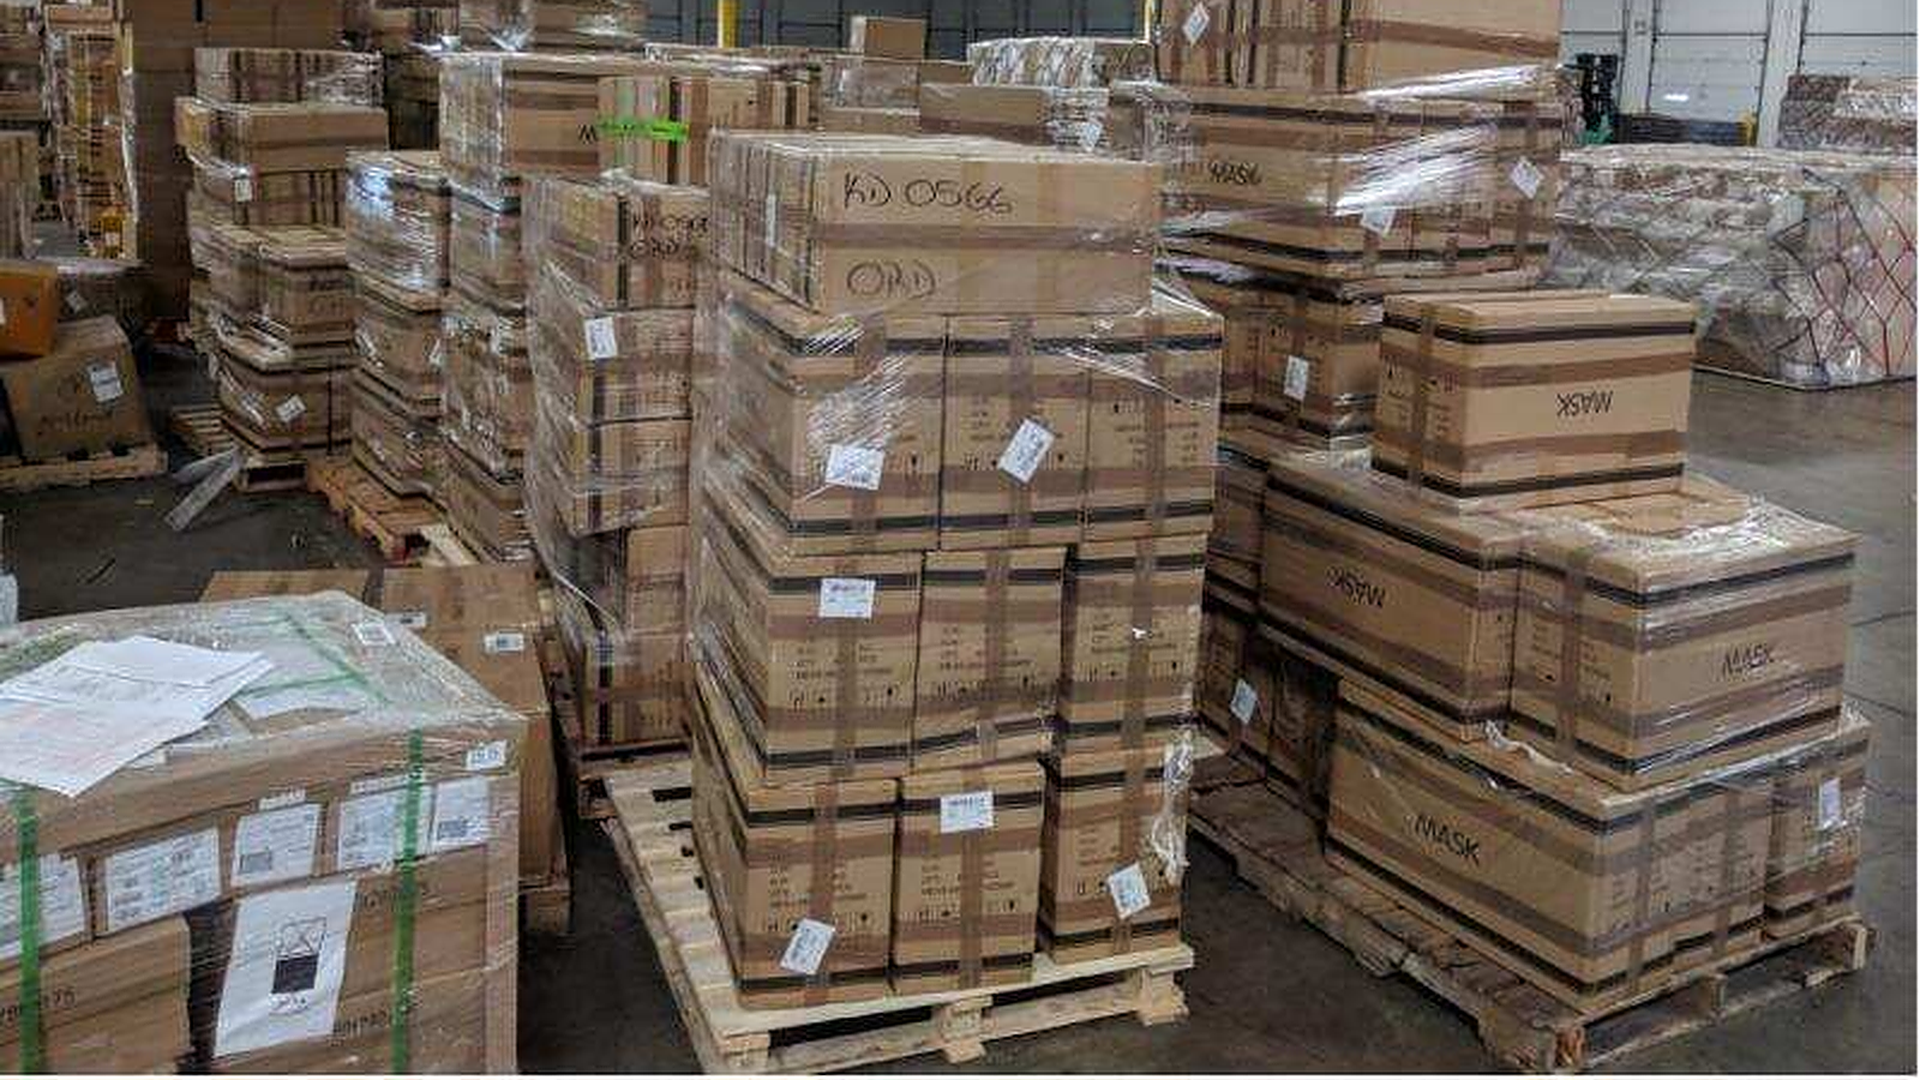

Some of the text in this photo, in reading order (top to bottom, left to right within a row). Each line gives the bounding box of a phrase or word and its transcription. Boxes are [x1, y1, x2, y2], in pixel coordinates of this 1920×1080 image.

[1556, 389, 1614, 417] MASK
[1325, 567, 1386, 609] MASK
[1414, 813, 1480, 868] MASK
